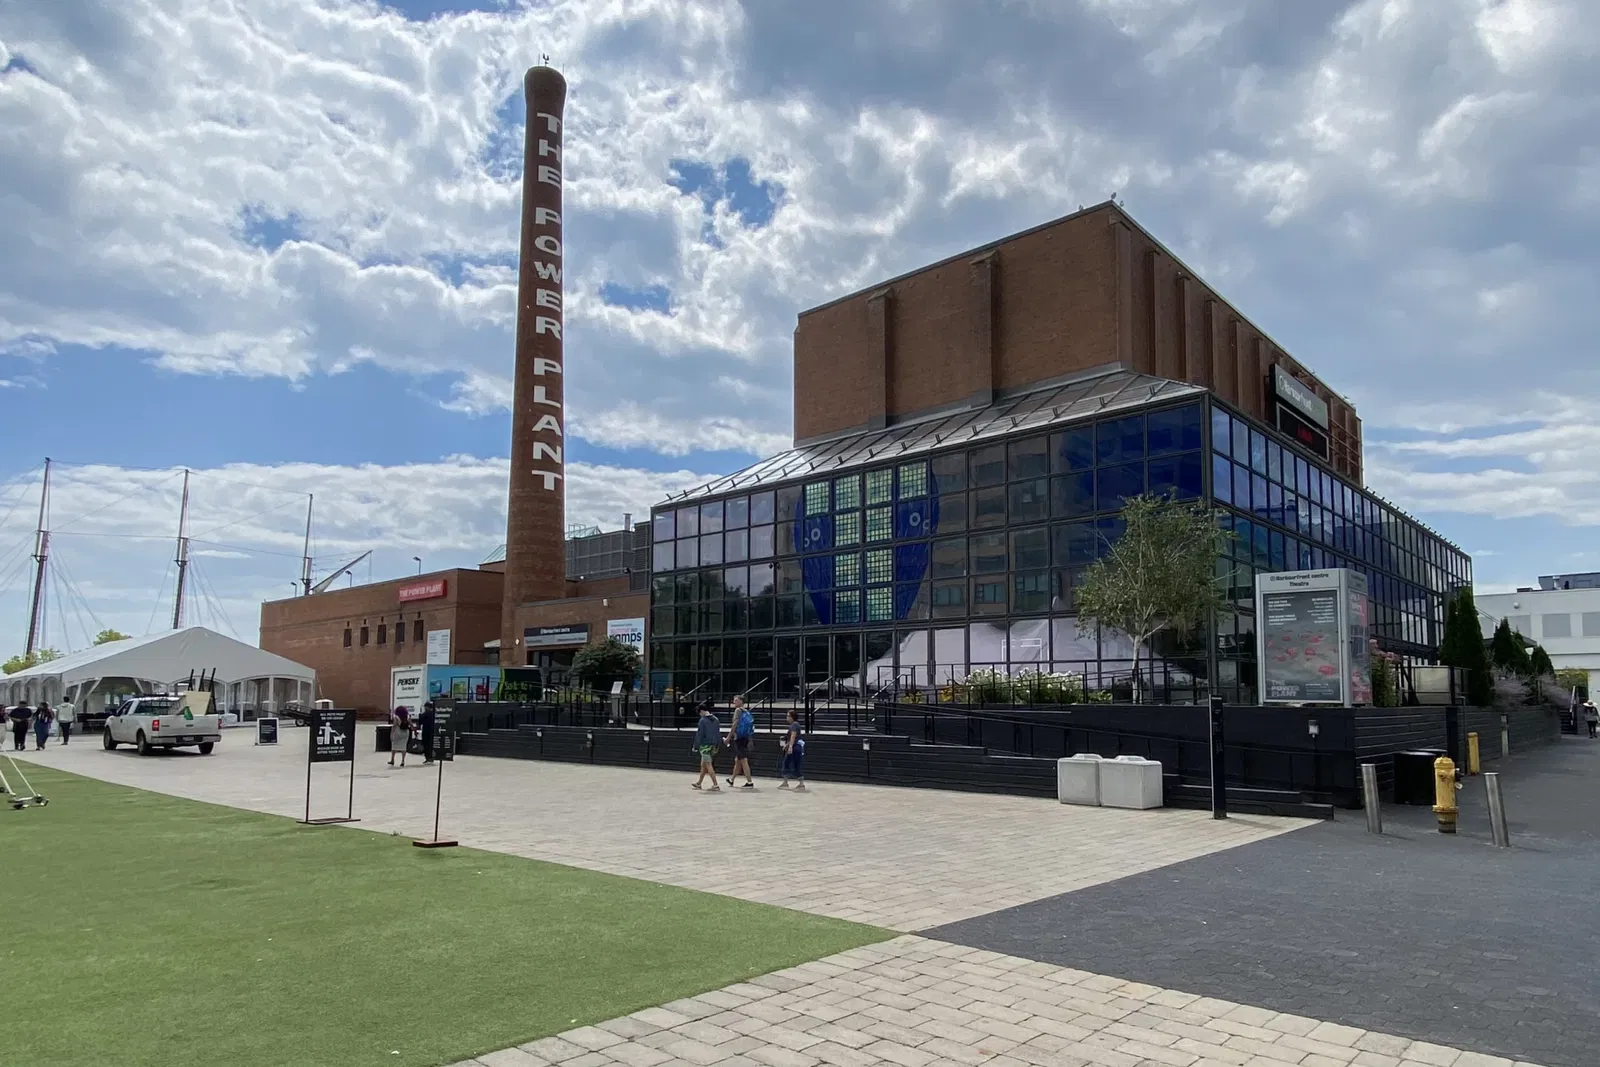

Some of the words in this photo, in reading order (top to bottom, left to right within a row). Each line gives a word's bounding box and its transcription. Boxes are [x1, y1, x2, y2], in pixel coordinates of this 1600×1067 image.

[537, 112, 562, 189] THE
[534, 206, 562, 340] POWER
[532, 357, 563, 491] PLANT
[409, 586, 426, 596] POWER
[426, 583, 442, 594] PLANT
[397, 677, 420, 686] PENSKE
